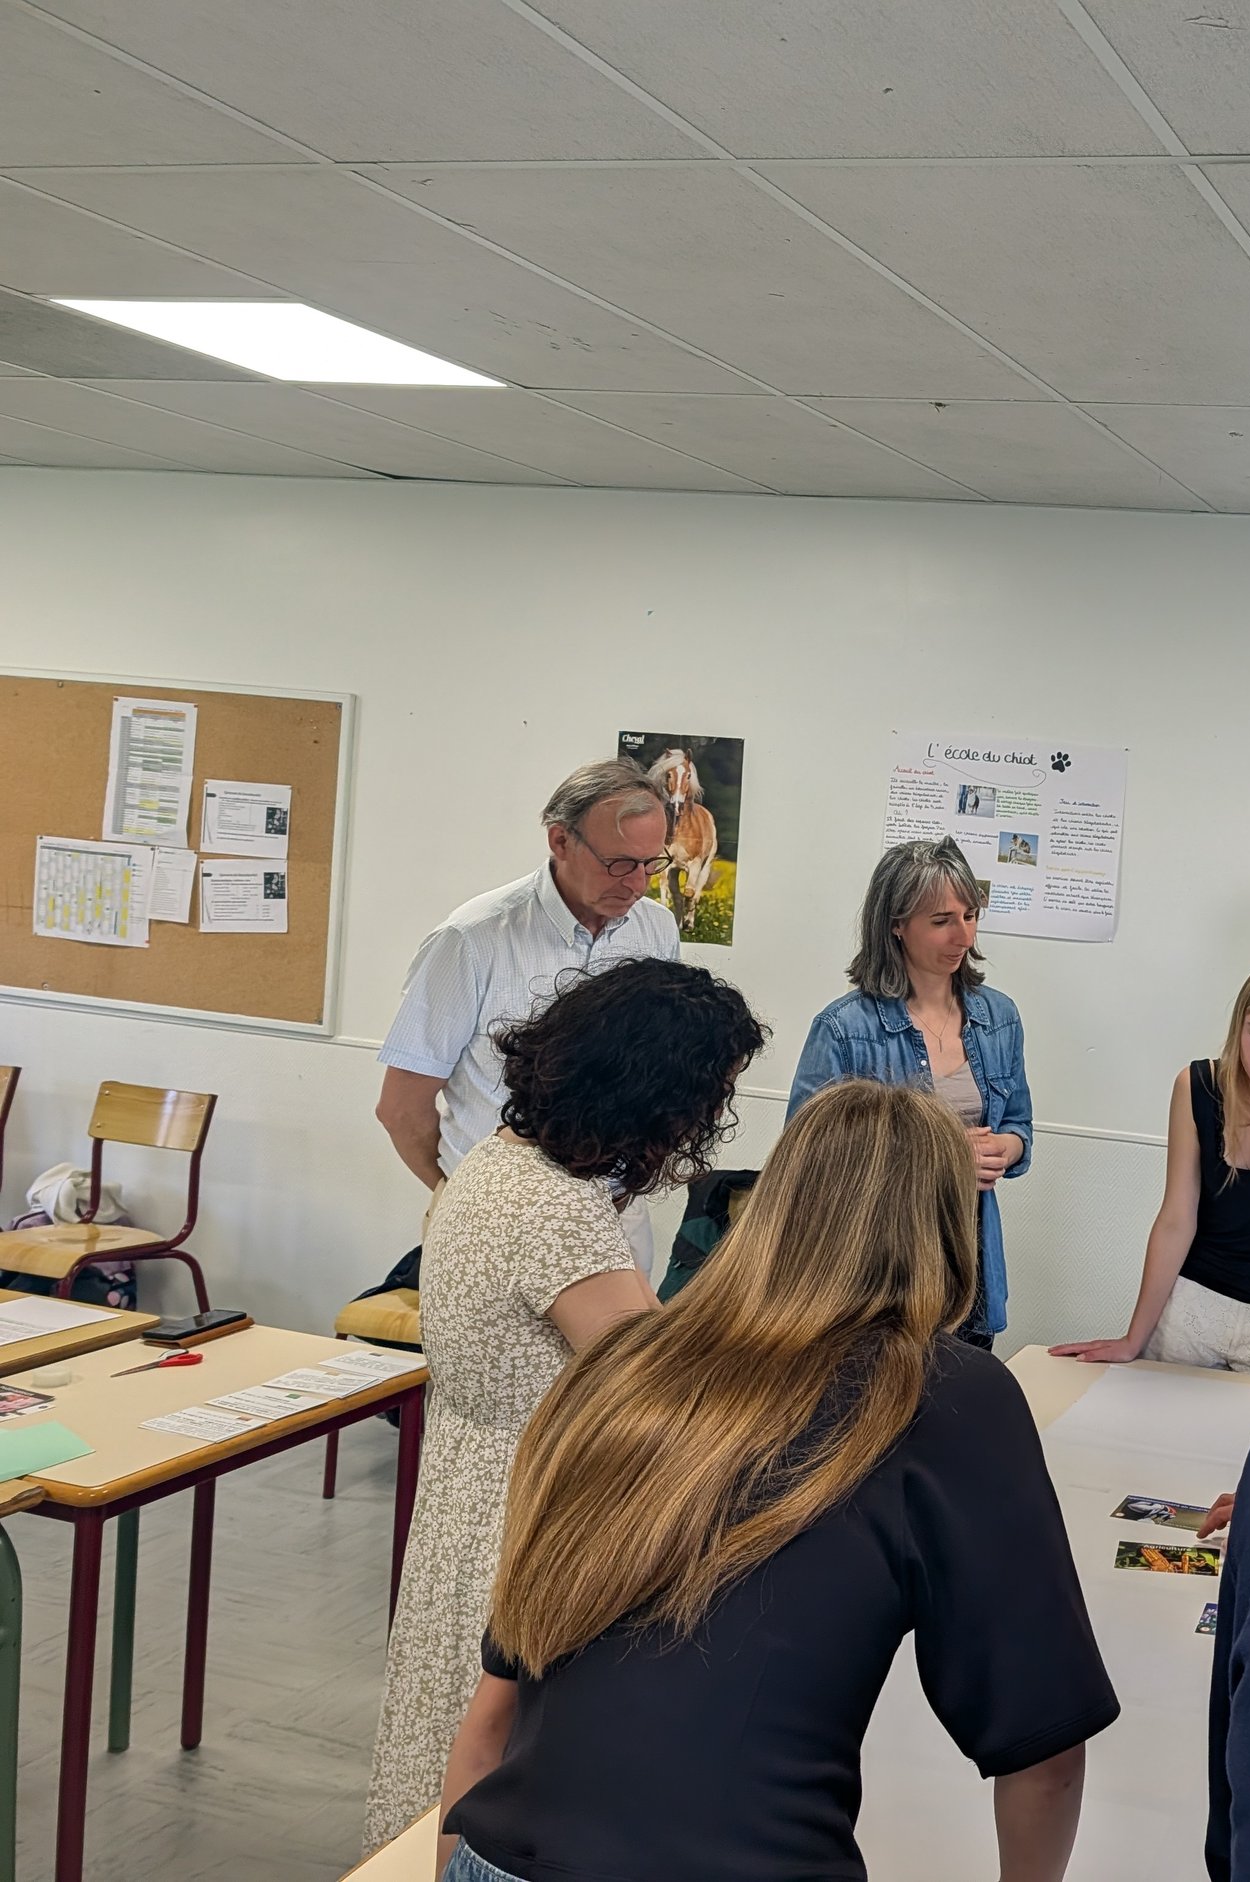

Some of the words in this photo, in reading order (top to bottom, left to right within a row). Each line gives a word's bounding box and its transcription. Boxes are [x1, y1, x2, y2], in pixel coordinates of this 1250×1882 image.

[928, 742, 940, 758] L'
[944, 744, 980, 761] école
[982, 751, 1000, 763] du
[1004, 752, 1038, 766] chiot
[1143, 1544, 1192, 1552] Agriculture
